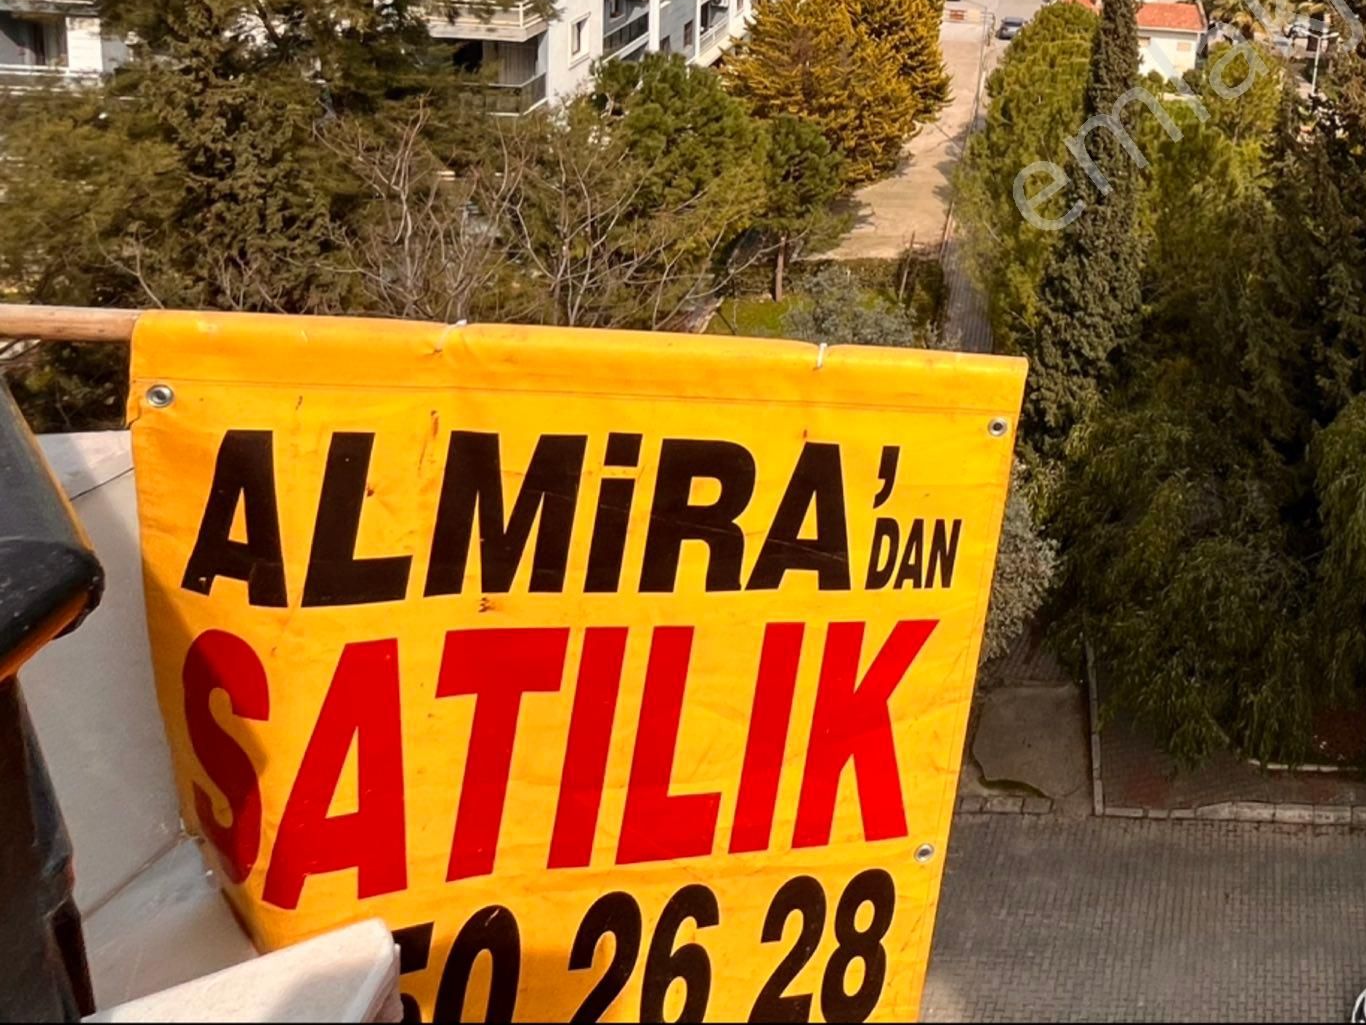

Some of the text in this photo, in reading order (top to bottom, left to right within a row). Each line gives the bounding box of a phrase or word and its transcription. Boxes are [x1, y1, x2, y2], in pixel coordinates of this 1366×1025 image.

[181, 619, 940, 910] SATILIK
[568, 883, 720, 1023] 26
[747, 868, 896, 1023] 28
